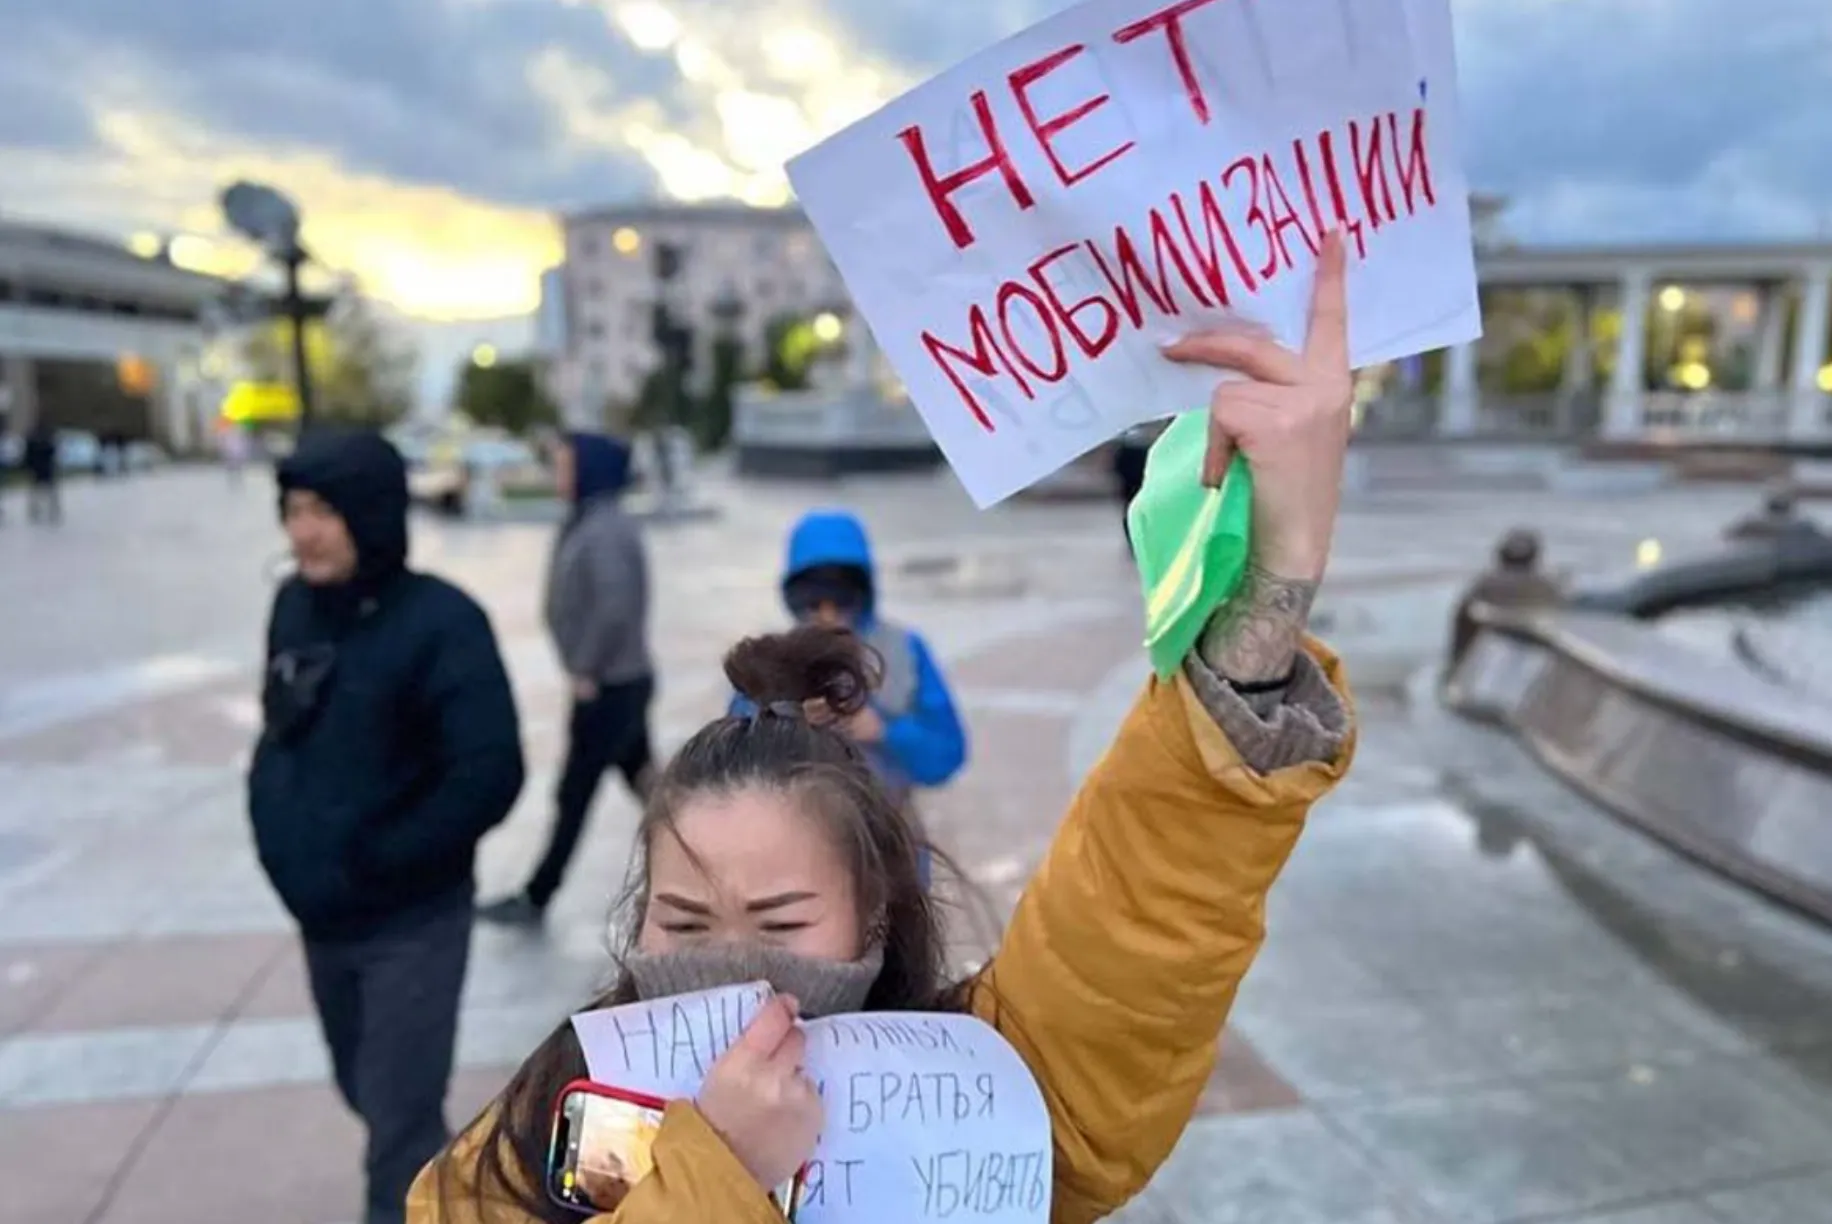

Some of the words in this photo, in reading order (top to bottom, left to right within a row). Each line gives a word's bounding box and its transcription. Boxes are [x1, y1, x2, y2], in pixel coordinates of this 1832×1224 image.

[895, 0, 1213, 250] НЕТ
[920, 108, 1436, 433] МОБИЛИЗАЦИИ
[612, 988, 772, 1079] НАШ
[848, 1071, 995, 1134] БРАТЬЯ
[910, 1148, 1045, 1219] УБИВАТЬ
